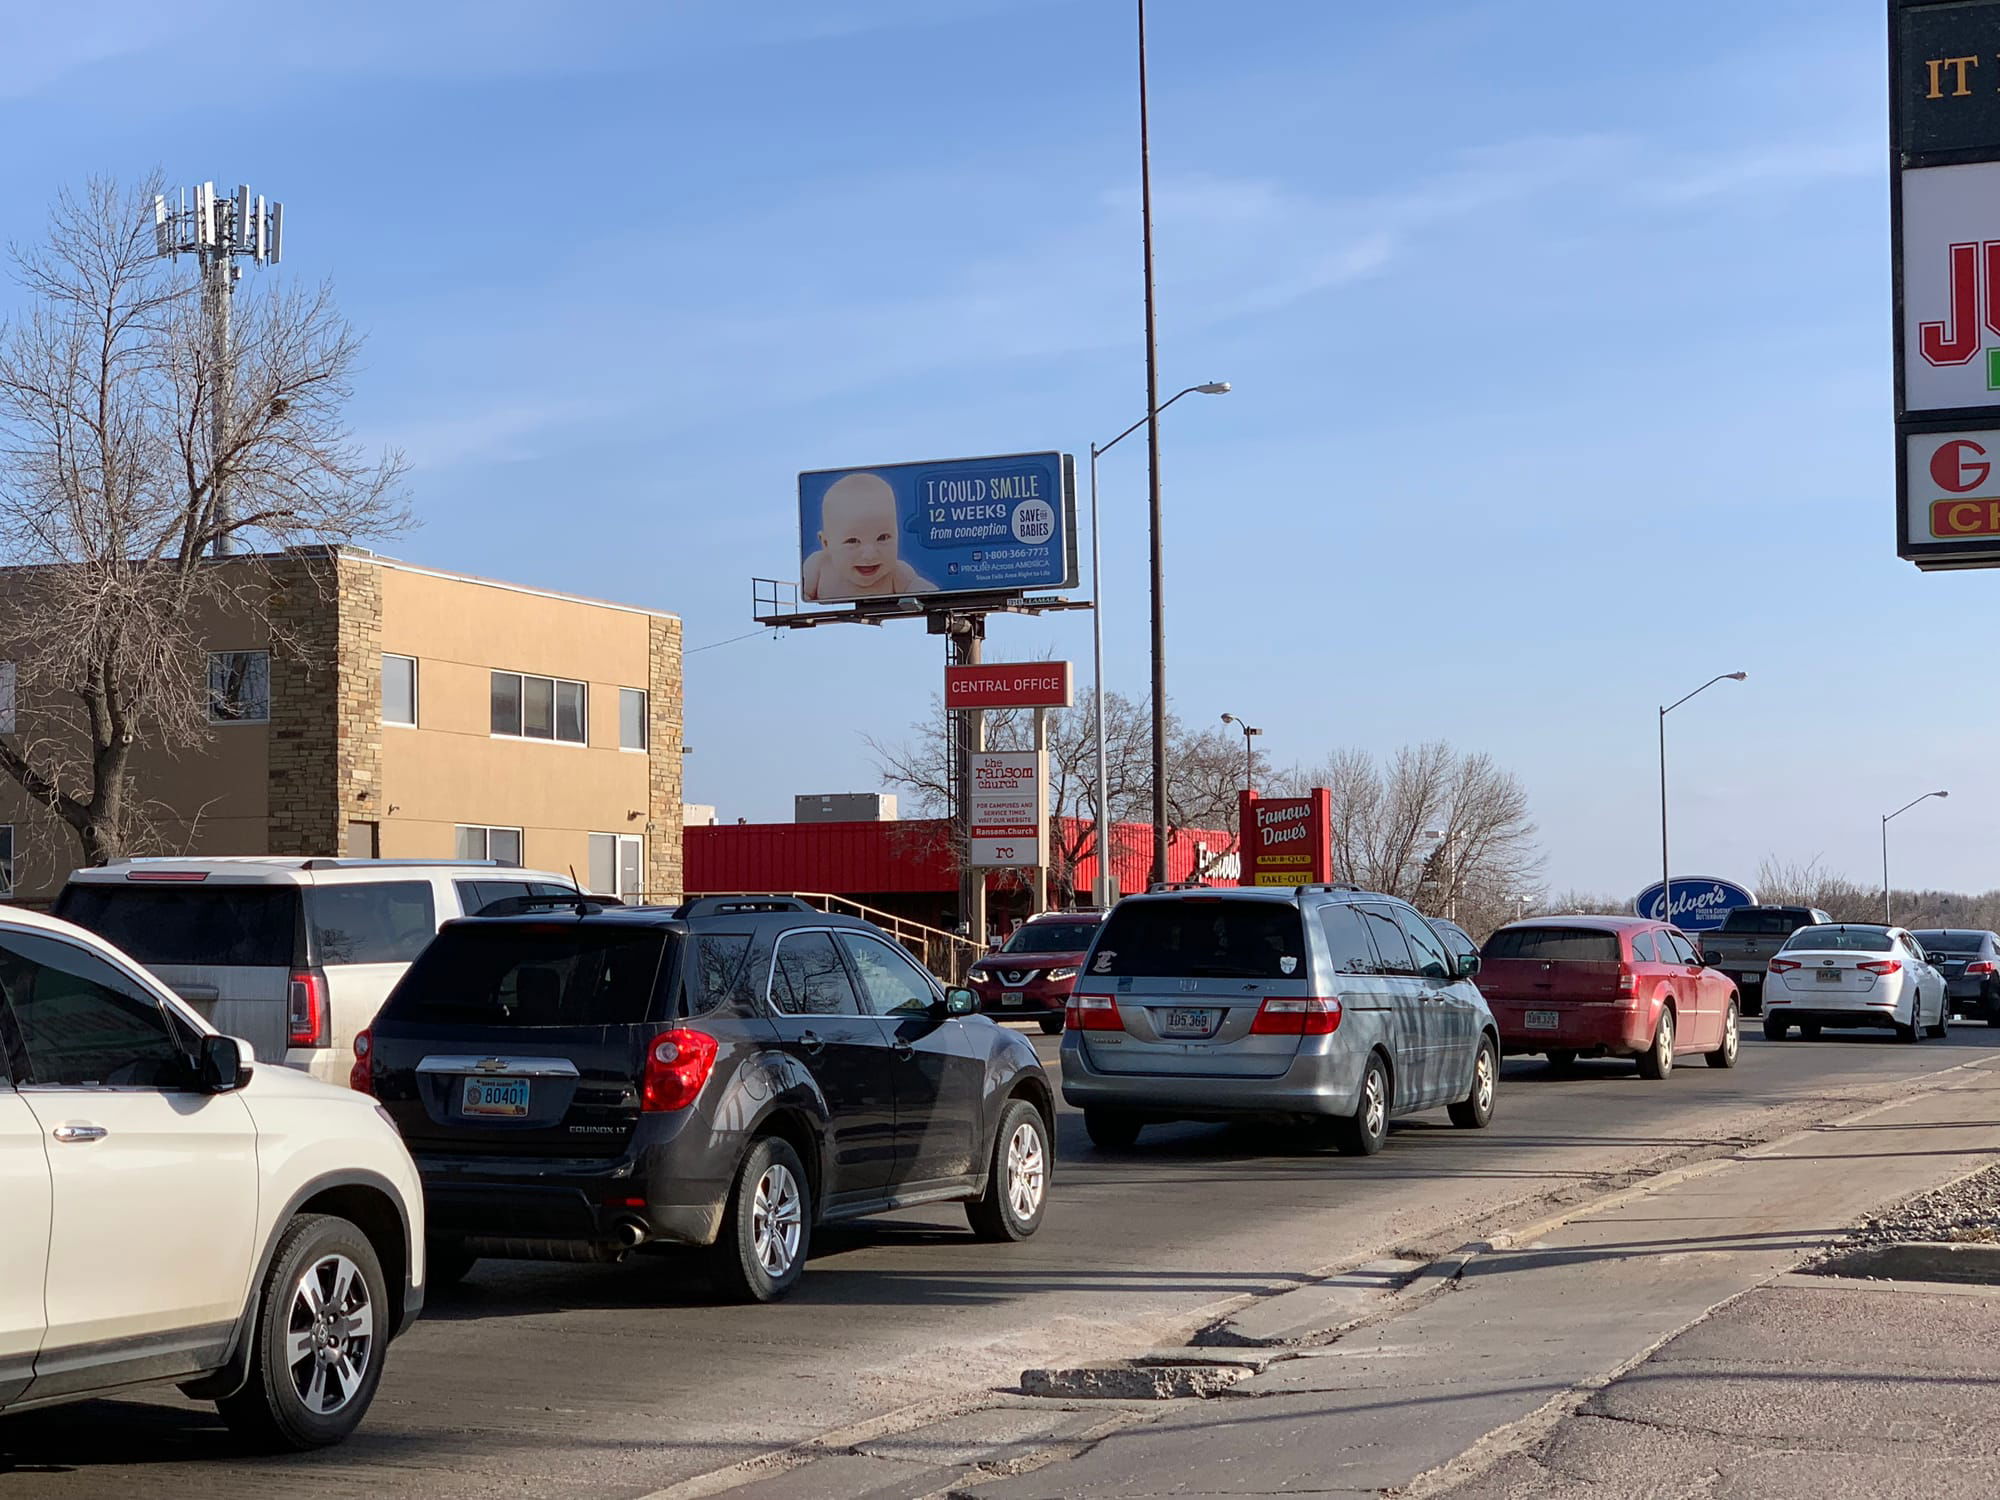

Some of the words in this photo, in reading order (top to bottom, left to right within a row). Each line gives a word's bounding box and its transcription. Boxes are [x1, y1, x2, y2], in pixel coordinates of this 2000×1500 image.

[1925, 55, 1978, 98] IT
[927, 480, 935, 505] I
[940, 479, 986, 504] COULD
[990, 475, 1040, 499] SMILE
[929, 508, 945, 522] 12
[951, 504, 1007, 521] WEEKS
[1020, 508, 1040, 522] SAVE
[930, 527, 952, 540] from
[955, 523, 1007, 539] conception
[1020, 523, 1049, 537] BABIES
[985, 547, 1049, 560] 1-800-366-7773
[1015, 559, 1050, 568] AMERICA
[952, 680, 1011, 693] CENTRAL
[1014, 678, 1059, 691] OFFICE
[984, 758, 1003, 768] the
[975, 767, 1034, 779] ransom
[978, 778, 1019, 789] church
[1256, 803, 1311, 827] Famous
[976, 828, 1034, 836] Ransom.Church
[1261, 822, 1306, 846] Dave's
[995, 847, 1014, 859] rc
[1260, 855, 1308, 864] BAR-B-QUE
[1261, 874, 1308, 884] TAKE-OUT
[1650, 884, 1726, 921] Culver's
[485, 1087, 524, 1105] 80401
[569, 1125, 614, 1134] EQUINOX
[616, 1126, 627, 1134] LT
